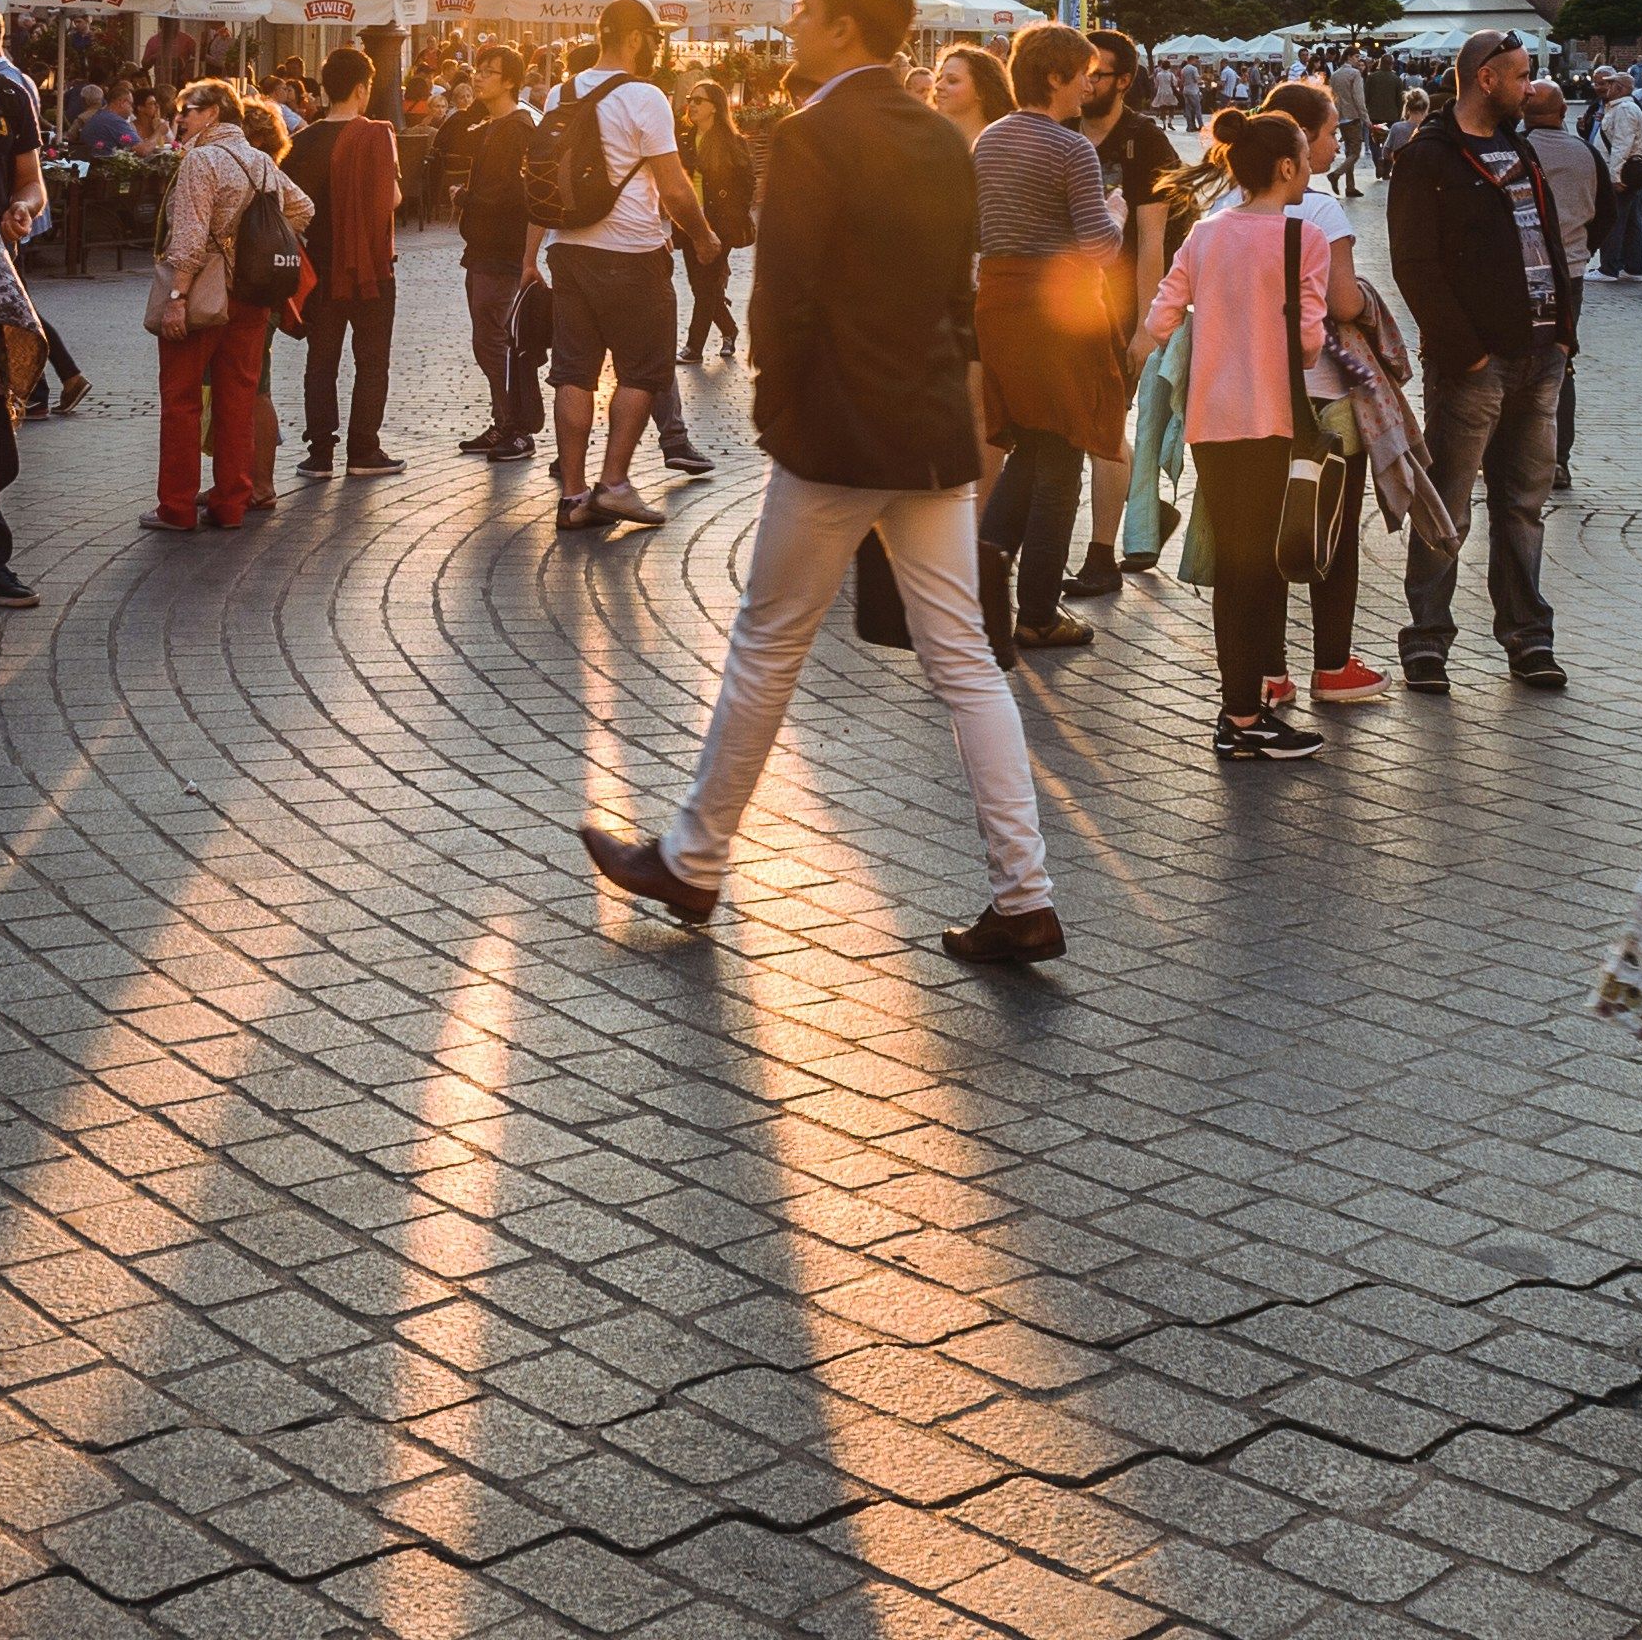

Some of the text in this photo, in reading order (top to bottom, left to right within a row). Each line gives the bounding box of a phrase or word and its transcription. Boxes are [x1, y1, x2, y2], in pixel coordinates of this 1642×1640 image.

[539, 3, 605, 18] MAX 18
[738, 0, 754, 15] 18
